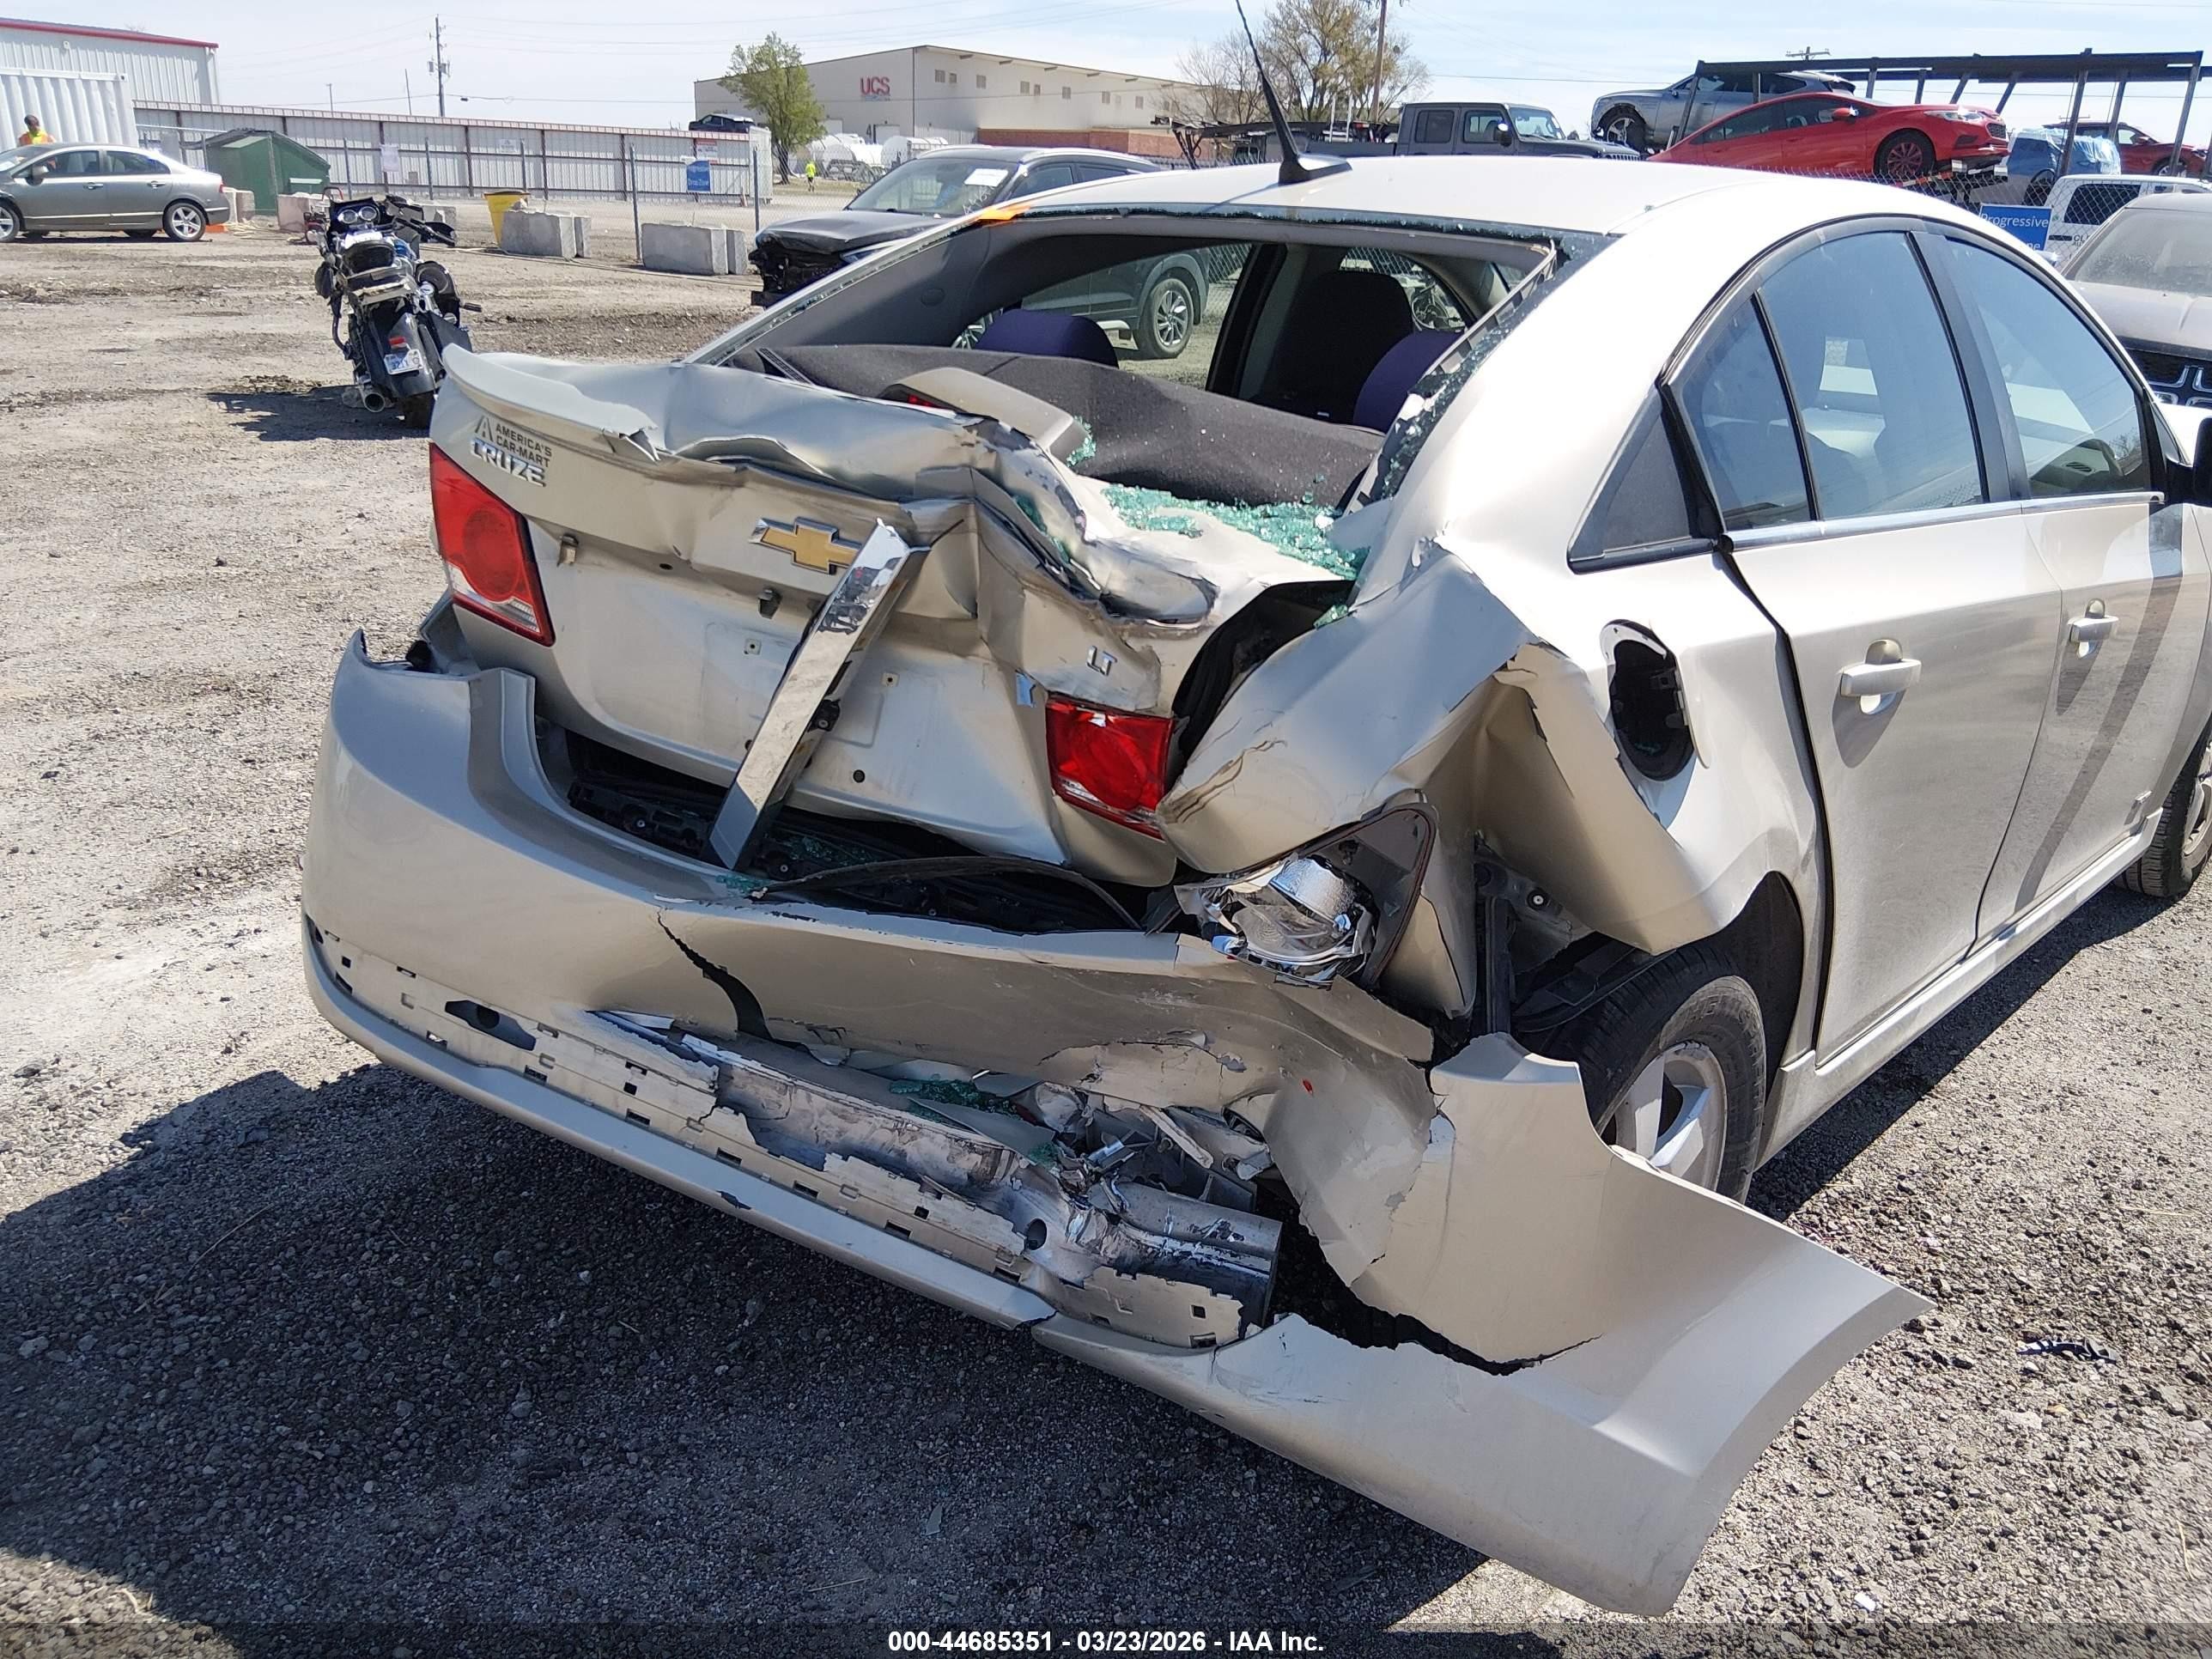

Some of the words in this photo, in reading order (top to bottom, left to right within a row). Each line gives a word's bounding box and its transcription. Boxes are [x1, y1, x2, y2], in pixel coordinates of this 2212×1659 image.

[860, 76, 890, 95] UCS
[495, 423, 552, 457] AMERICA'S
[496, 435, 550, 467] CAR-MART
[470, 437, 546, 487] CRUZE
[1086, 645, 1117, 677] LT
